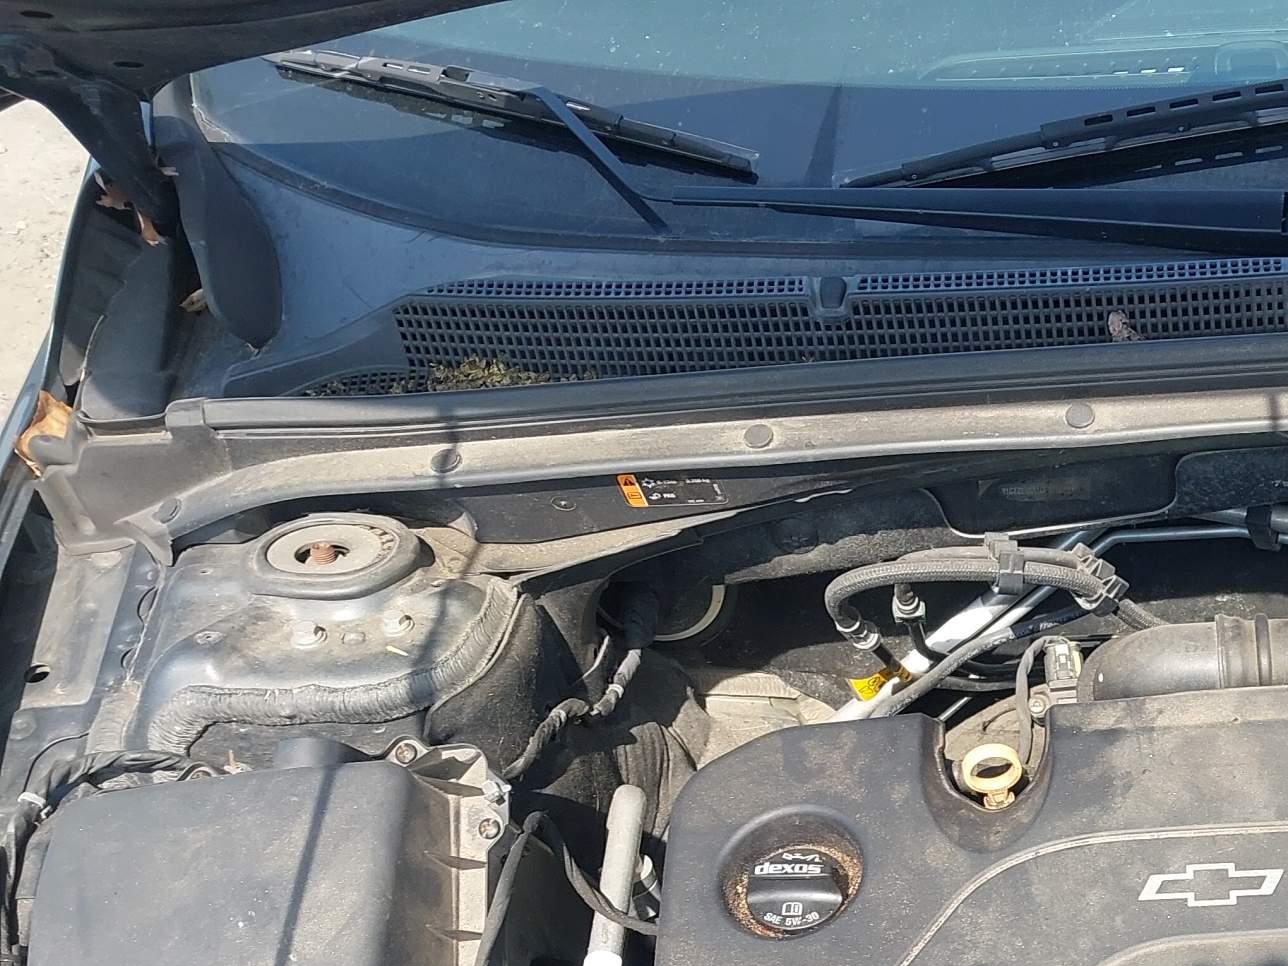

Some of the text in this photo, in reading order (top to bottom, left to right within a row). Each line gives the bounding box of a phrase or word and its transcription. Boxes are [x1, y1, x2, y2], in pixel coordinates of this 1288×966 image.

[754, 861, 824, 875] dexos
[763, 911, 820, 926] SAE 5W-30
